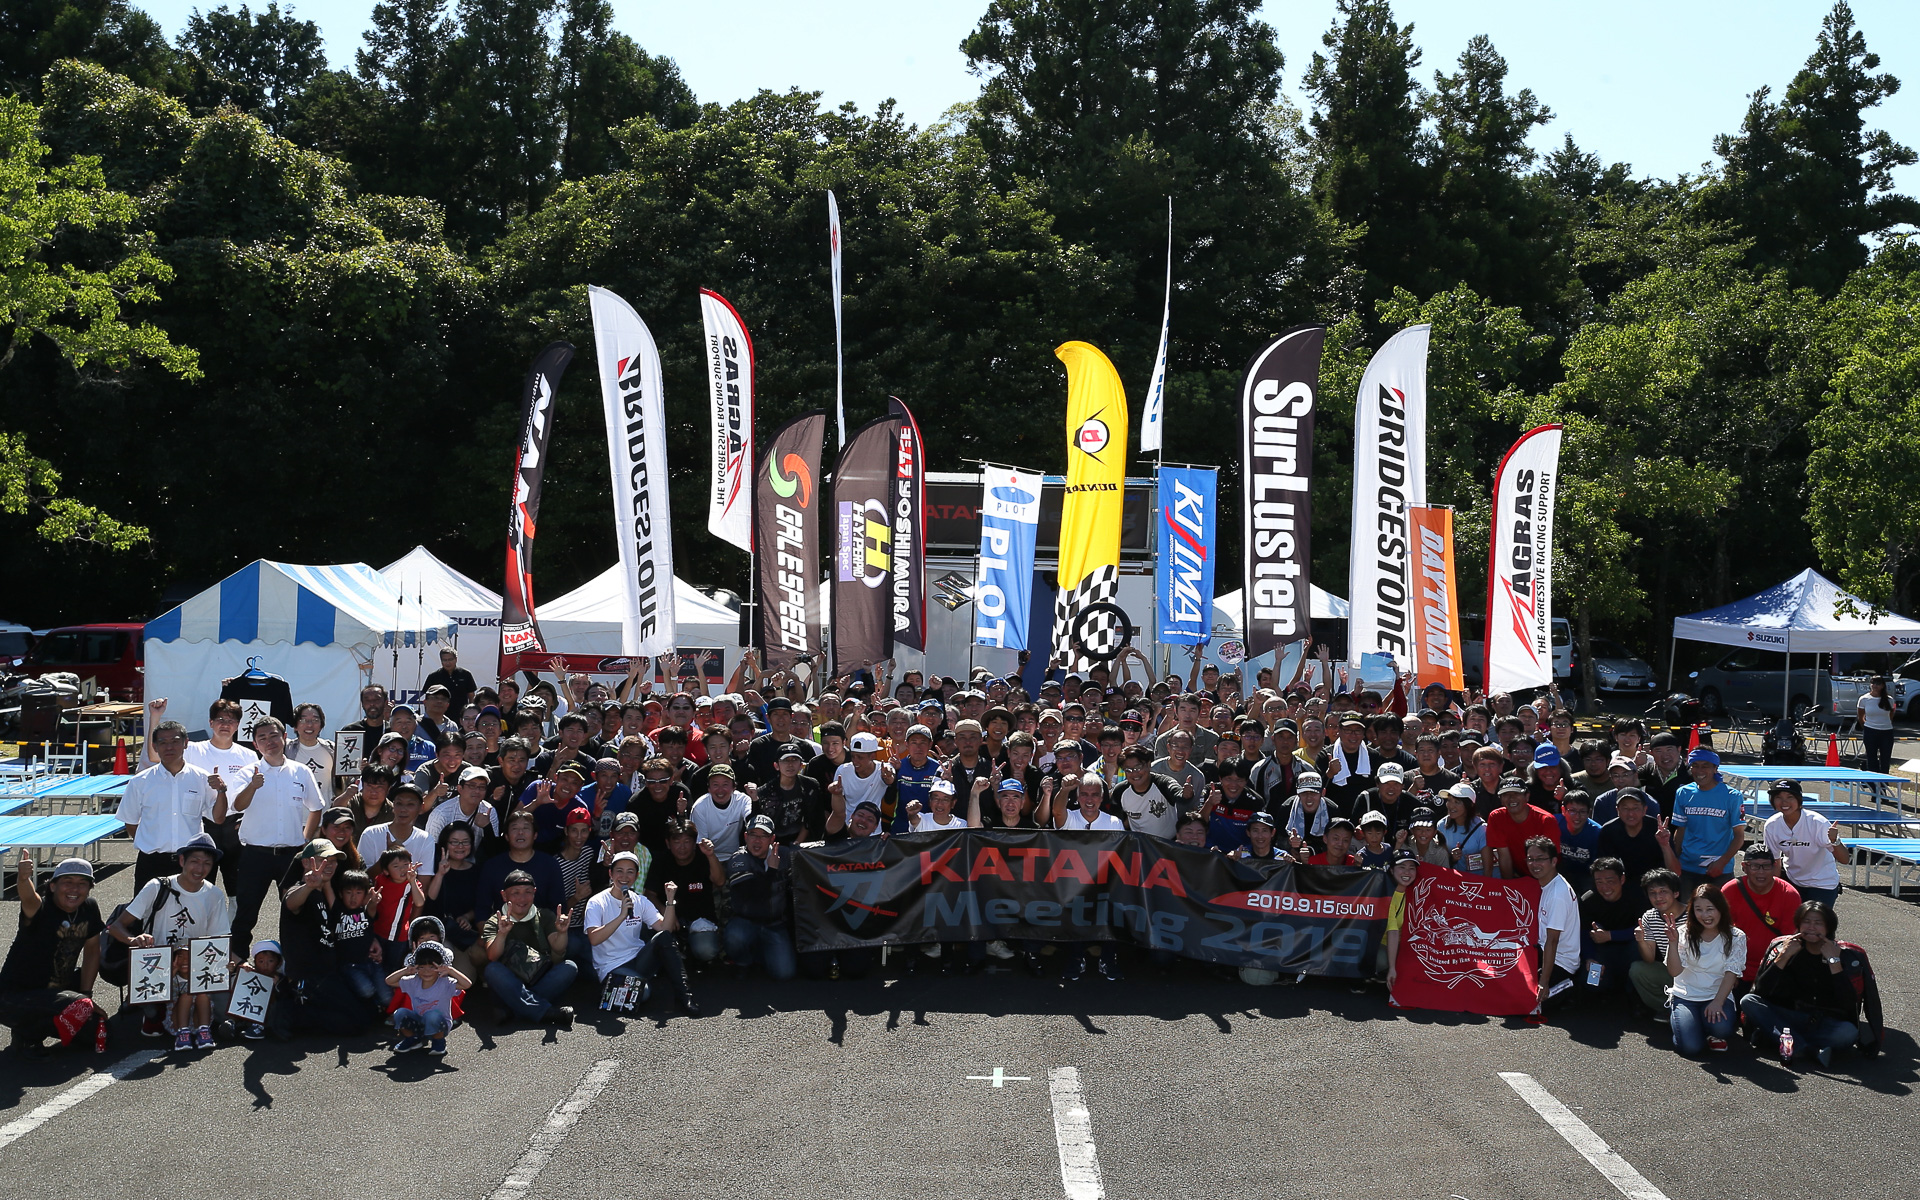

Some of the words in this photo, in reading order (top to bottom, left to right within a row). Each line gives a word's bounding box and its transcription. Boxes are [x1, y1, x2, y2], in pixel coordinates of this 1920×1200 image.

[996, 502, 1026, 516] PLOT
[1253, 379, 1314, 636] SurLuster
[1377, 383, 1405, 656] BRIDGESTONE
[1539, 472, 1551, 522] SUPPORT
[839, 513, 850, 544] Japan
[852, 501, 866, 578] HYPERPRO
[1165, 478, 1207, 623] KIJIMA
[1511, 469, 1535, 597] AGRAS
[1536, 524, 1548, 565] RACING
[840, 545, 850, 571] Spec
[894, 481, 912, 632] YOSHIMURA
[976, 525, 1010, 648] PLOT
[1420, 524, 1453, 670] DAYTONA
[1537, 567, 1546, 632] AGGRESSIVE
[1537, 635, 1547, 655] THE
[1755, 634, 1785, 644] SUZUKI
[826, 860, 886, 873] KATANA
[920, 847, 1188, 897] KATANA
[1560, 849, 1591, 859] UZUKI
[1437, 884, 1456, 892] SINCE
[1445, 899, 1473, 909] OWNER'S
[923, 890, 1189, 952] Meeting
[1200, 911, 1369, 963] 2019
[237, 975, 268, 1017] 令和
